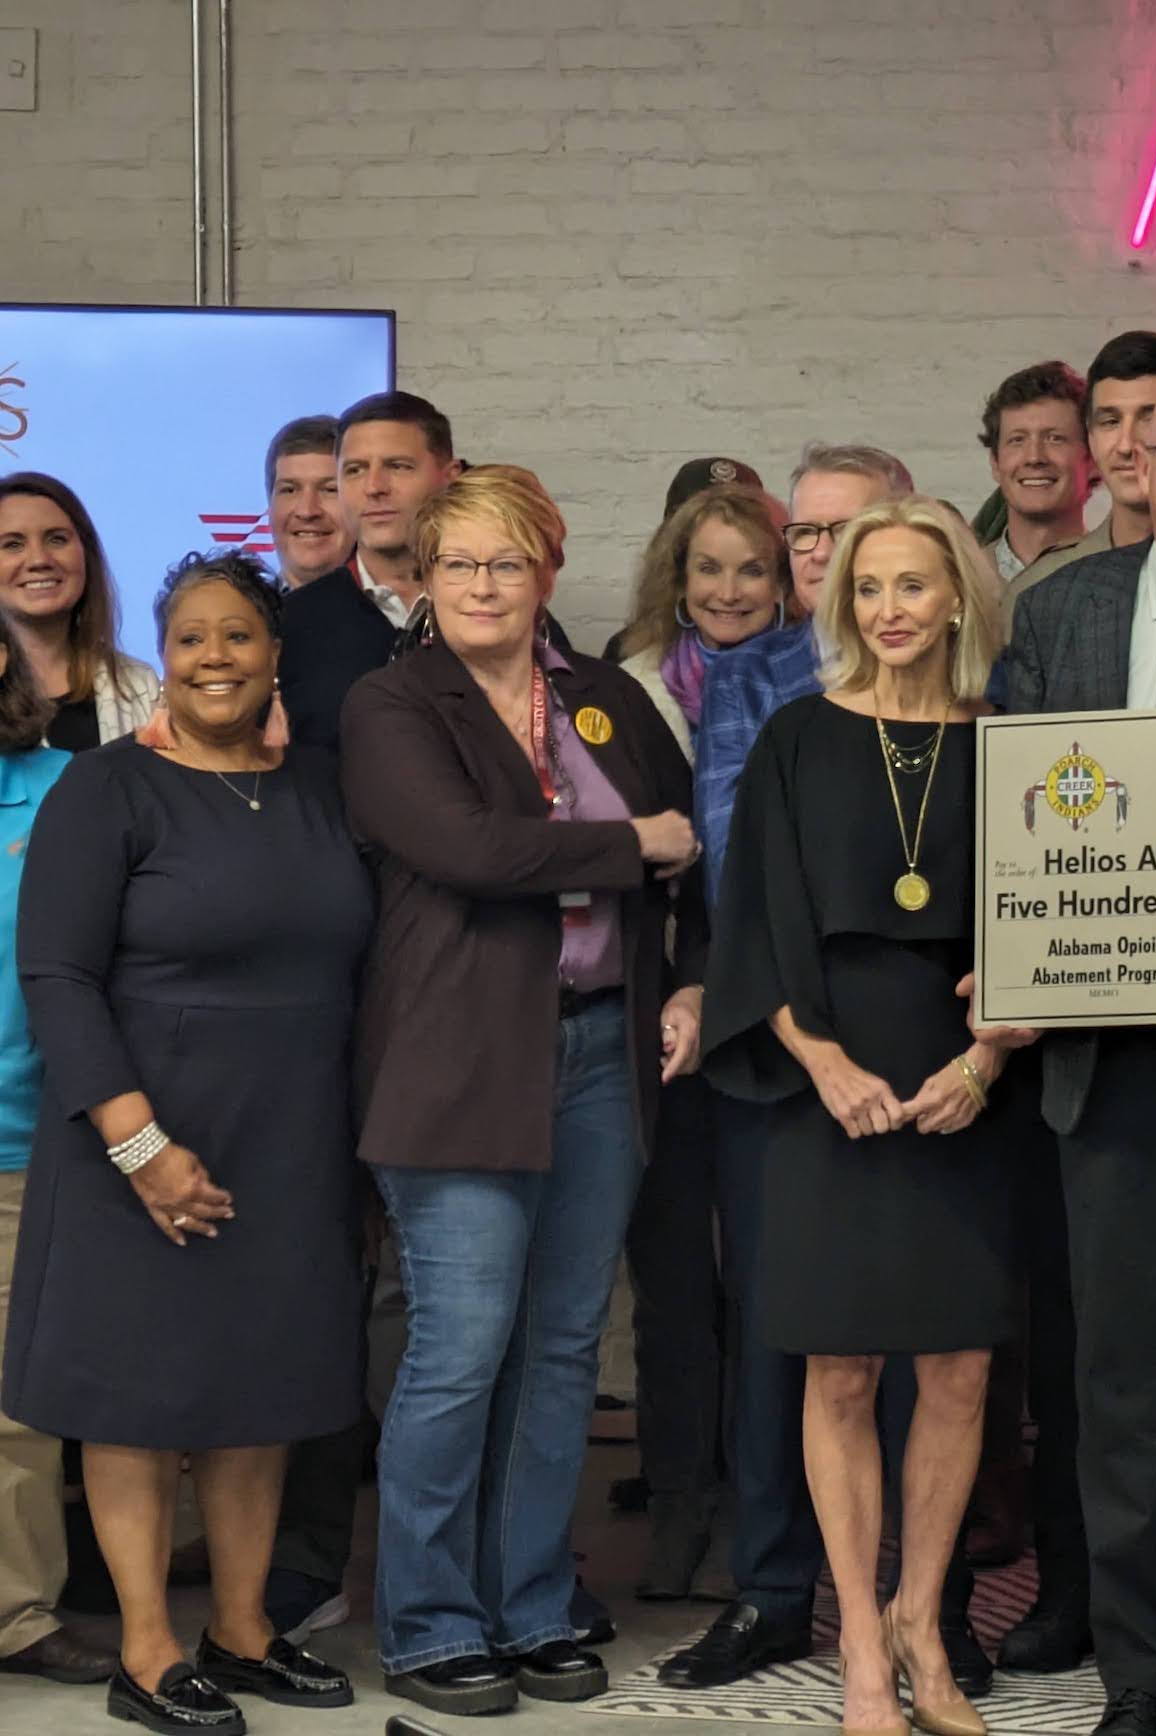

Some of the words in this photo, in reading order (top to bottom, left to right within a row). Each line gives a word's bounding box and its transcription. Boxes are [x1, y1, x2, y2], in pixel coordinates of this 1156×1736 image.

[1054, 757, 1096, 774] POARCH
[1057, 780, 1094, 792] CREEK
[1053, 800, 1100, 817] INDIANS
[1044, 845, 1127, 875] Helios
[996, 892, 1049, 919] Five
[1047, 938, 1112, 957] Alabama
[1032, 967, 1112, 985] Abatement
